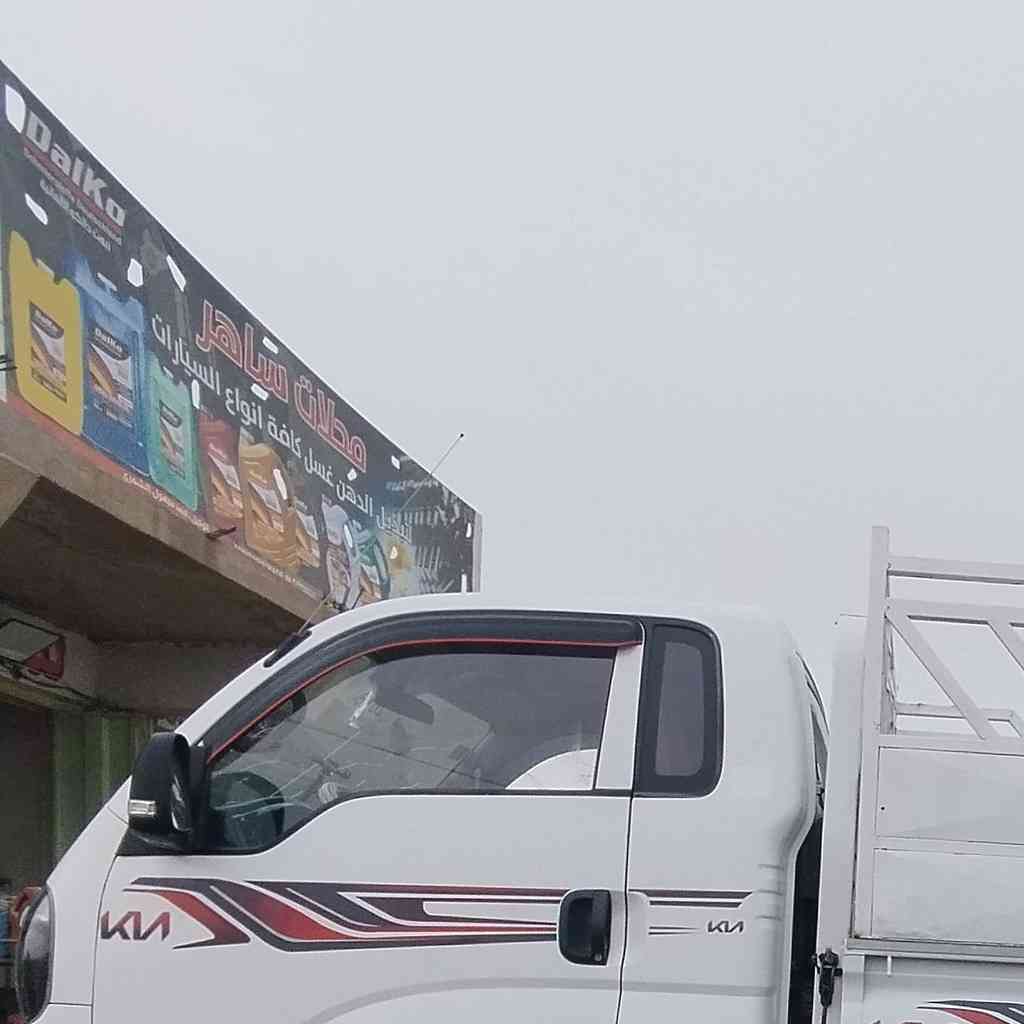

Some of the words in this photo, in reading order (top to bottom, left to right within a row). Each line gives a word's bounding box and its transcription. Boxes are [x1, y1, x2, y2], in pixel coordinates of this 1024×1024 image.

[152, 313, 221, 396] السيارات
[195, 299, 289, 404] ساهر
[225, 387, 262, 430] انواع
[294, 374, 367, 473] محلات
[267, 414, 302, 459] كافة
[304, 447, 335, 487] غسل
[336, 479, 373, 518] الدهن
[101, 910, 170, 943] KIA
[707, 920, 745, 934] KIA
